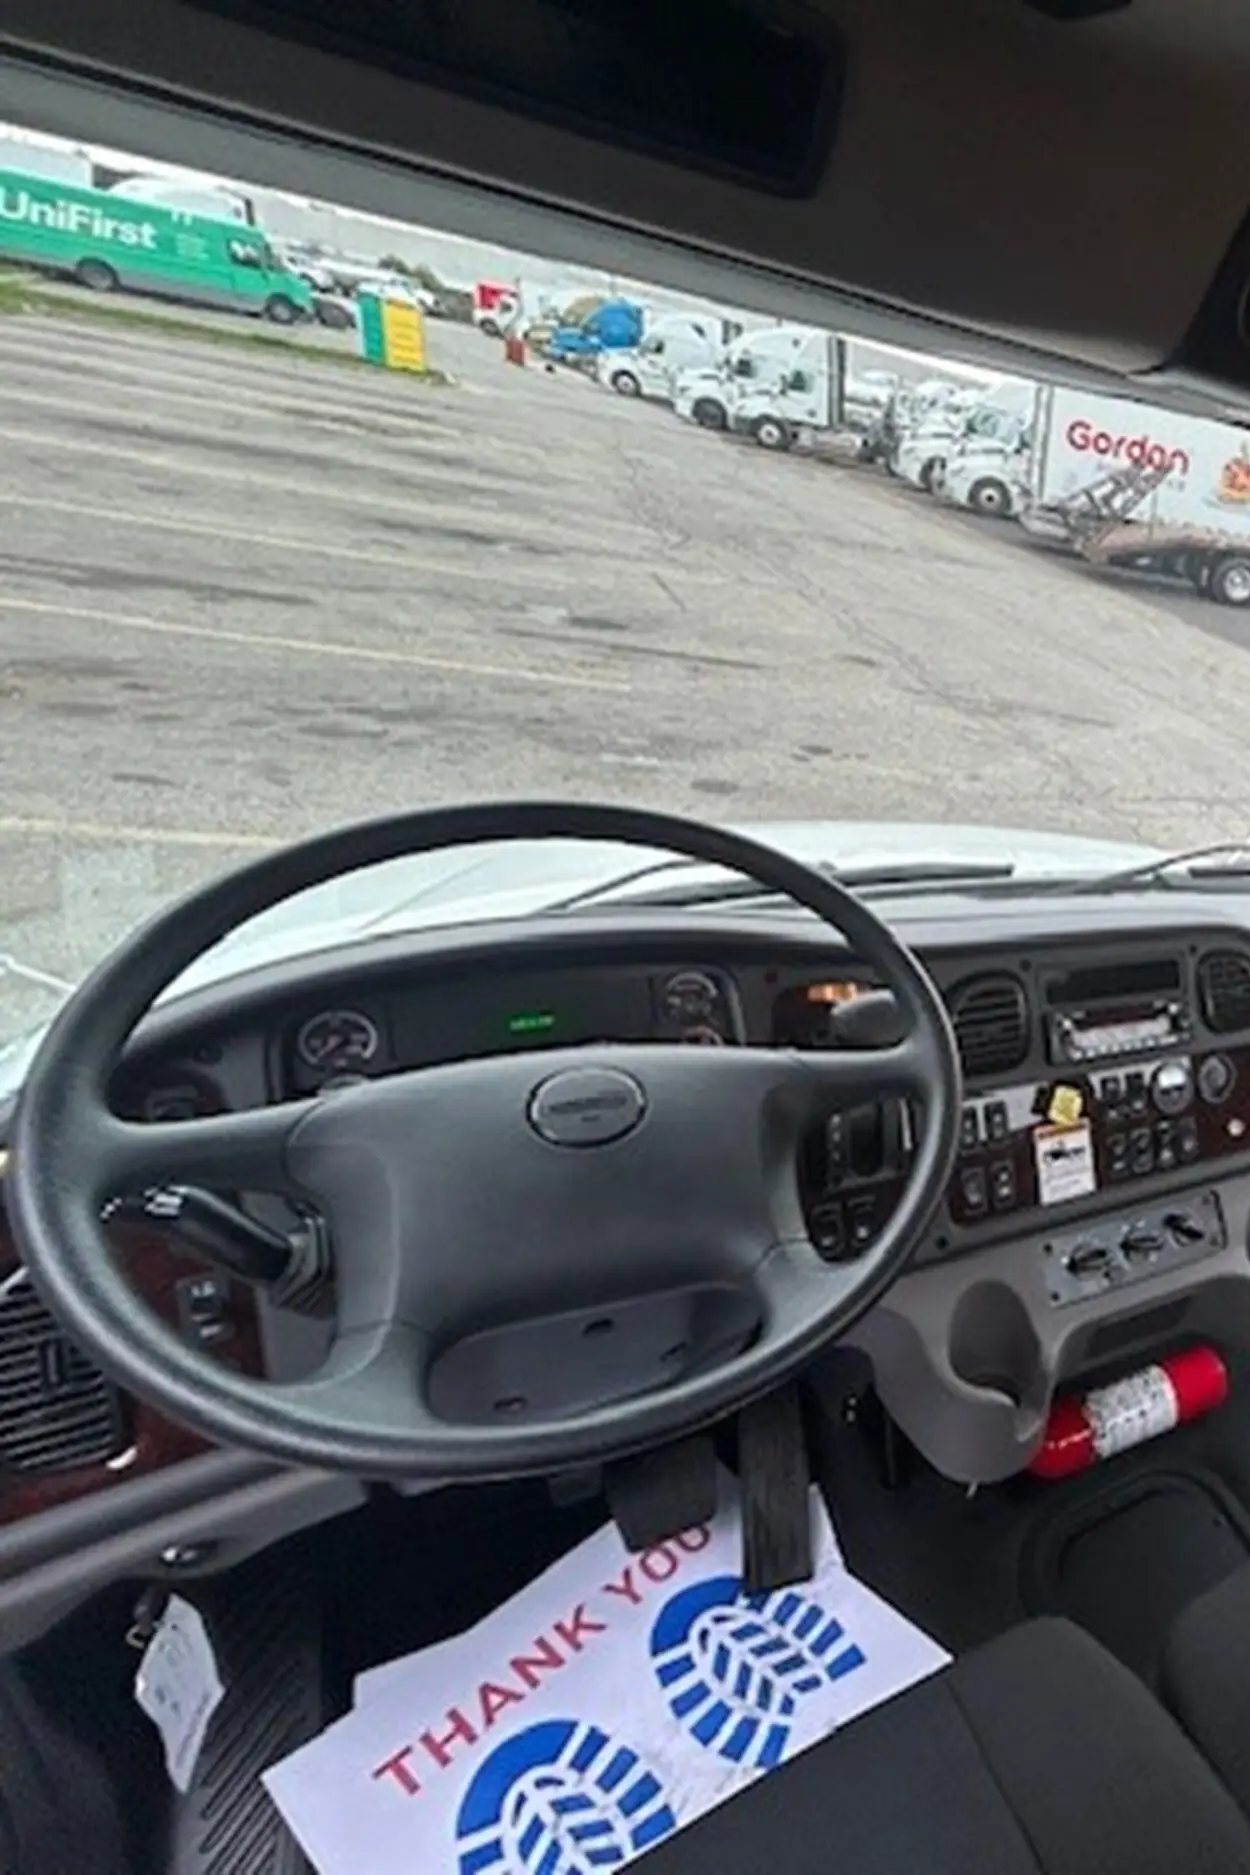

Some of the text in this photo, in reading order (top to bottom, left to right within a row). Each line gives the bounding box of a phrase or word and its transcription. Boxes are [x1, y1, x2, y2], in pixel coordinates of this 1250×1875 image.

[0, 185, 158, 249] UniFirst
[1066, 420, 1190, 477] Gordon
[372, 1602, 607, 1796] THANK
[602, 1524, 711, 1605] YOU
